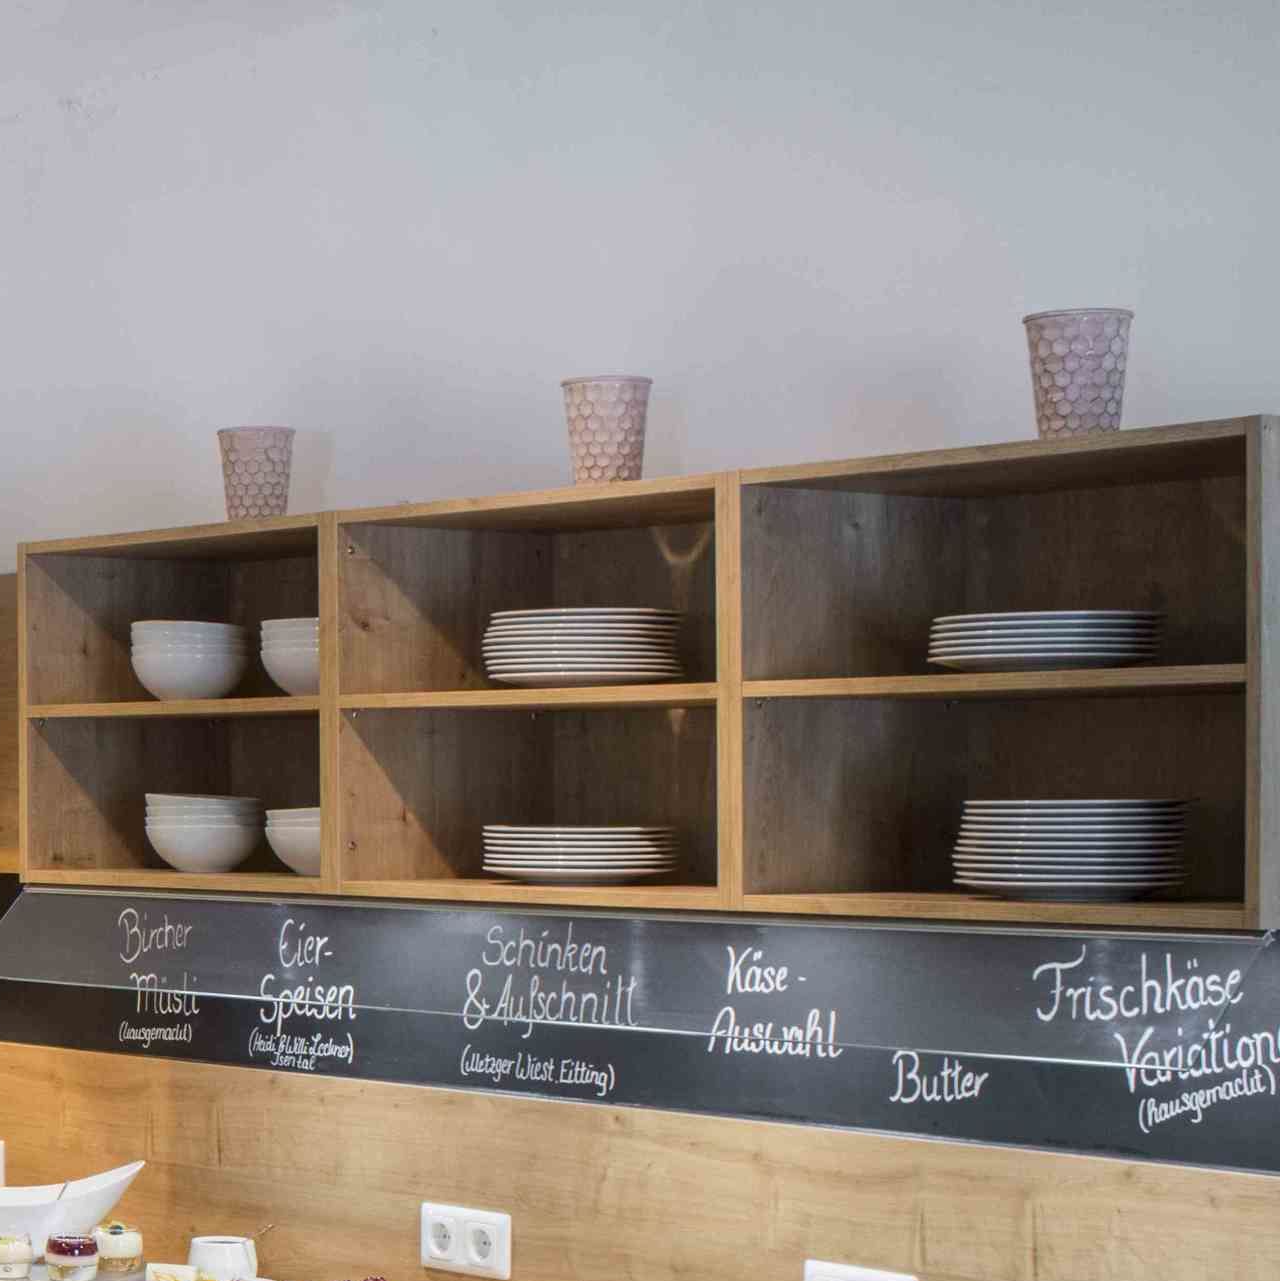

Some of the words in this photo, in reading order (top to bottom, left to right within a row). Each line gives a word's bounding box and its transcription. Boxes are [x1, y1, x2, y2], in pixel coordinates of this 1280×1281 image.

[118, 907, 193, 964] Bircher
[278, 918, 334, 968] Eier-
[481, 920, 608, 975] Schinken
[129, 971, 200, 1017] Müsli
[258, 973, 357, 1037] Speisen
[462, 968, 491, 1030] &
[491, 972, 639, 1040] Aufschnitt
[1031, 943, 1245, 1022] Frischkäse
[118, 1020, 193, 1049] (hausgemacht)
[706, 1005, 844, 1058] Auswahl
[1113, 1017, 1280, 1094] Variation
[460, 1043, 516, 1083] (Metzger
[559, 1058, 616, 1097] Eitting)
[888, 1048, 990, 1104] Butter
[1138, 1062, 1277, 1134] (hausgemacht)
